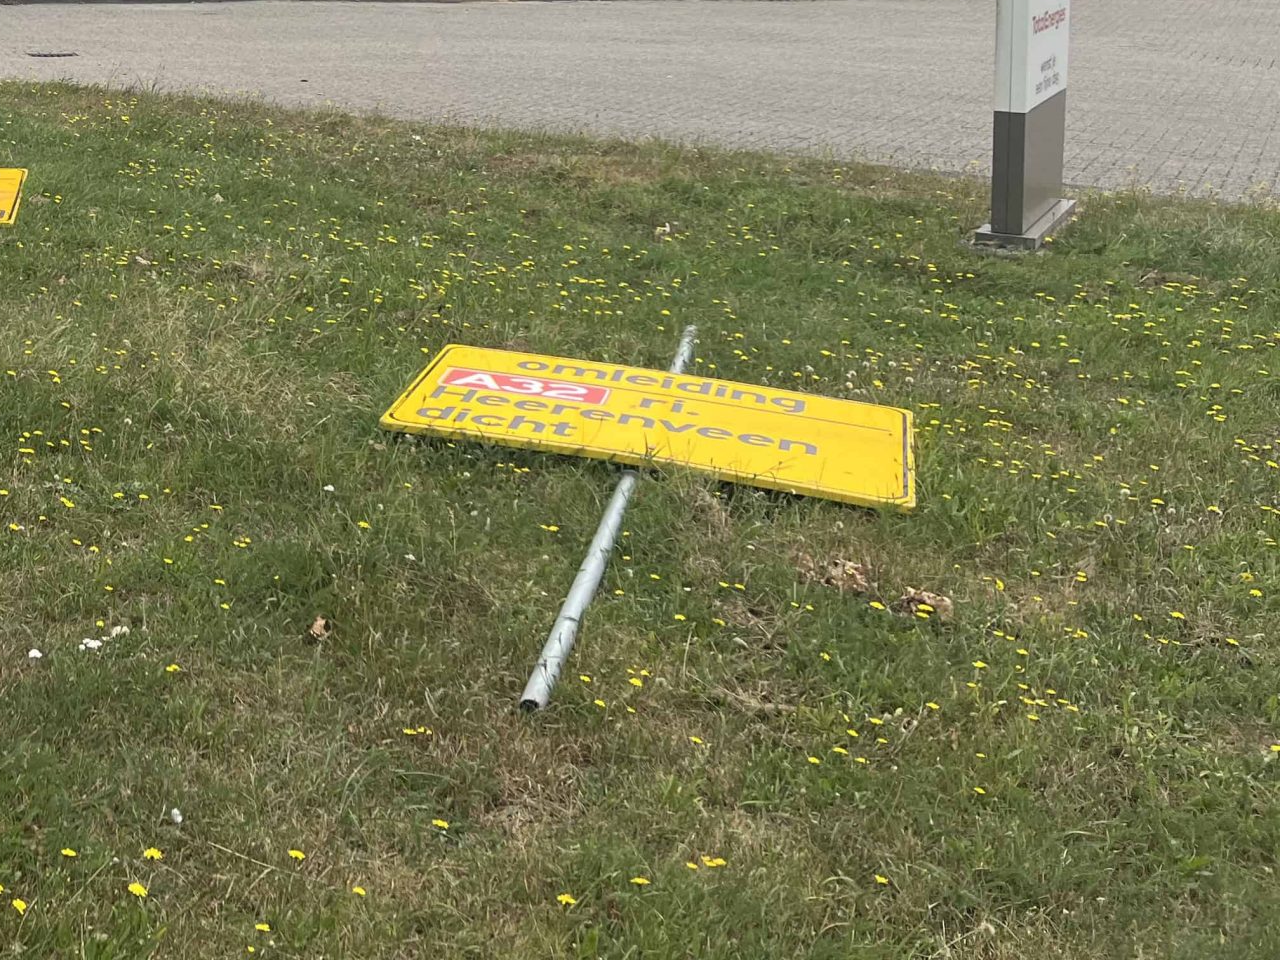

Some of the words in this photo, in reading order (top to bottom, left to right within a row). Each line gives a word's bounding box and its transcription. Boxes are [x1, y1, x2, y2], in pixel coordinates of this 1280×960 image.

[447, 372, 589, 402] A32
[638, 396, 700, 416] ri.
[517, 360, 807, 414] omleiding
[416, 405, 579, 438] dicht
[428, 385, 820, 456] Heerenveen
